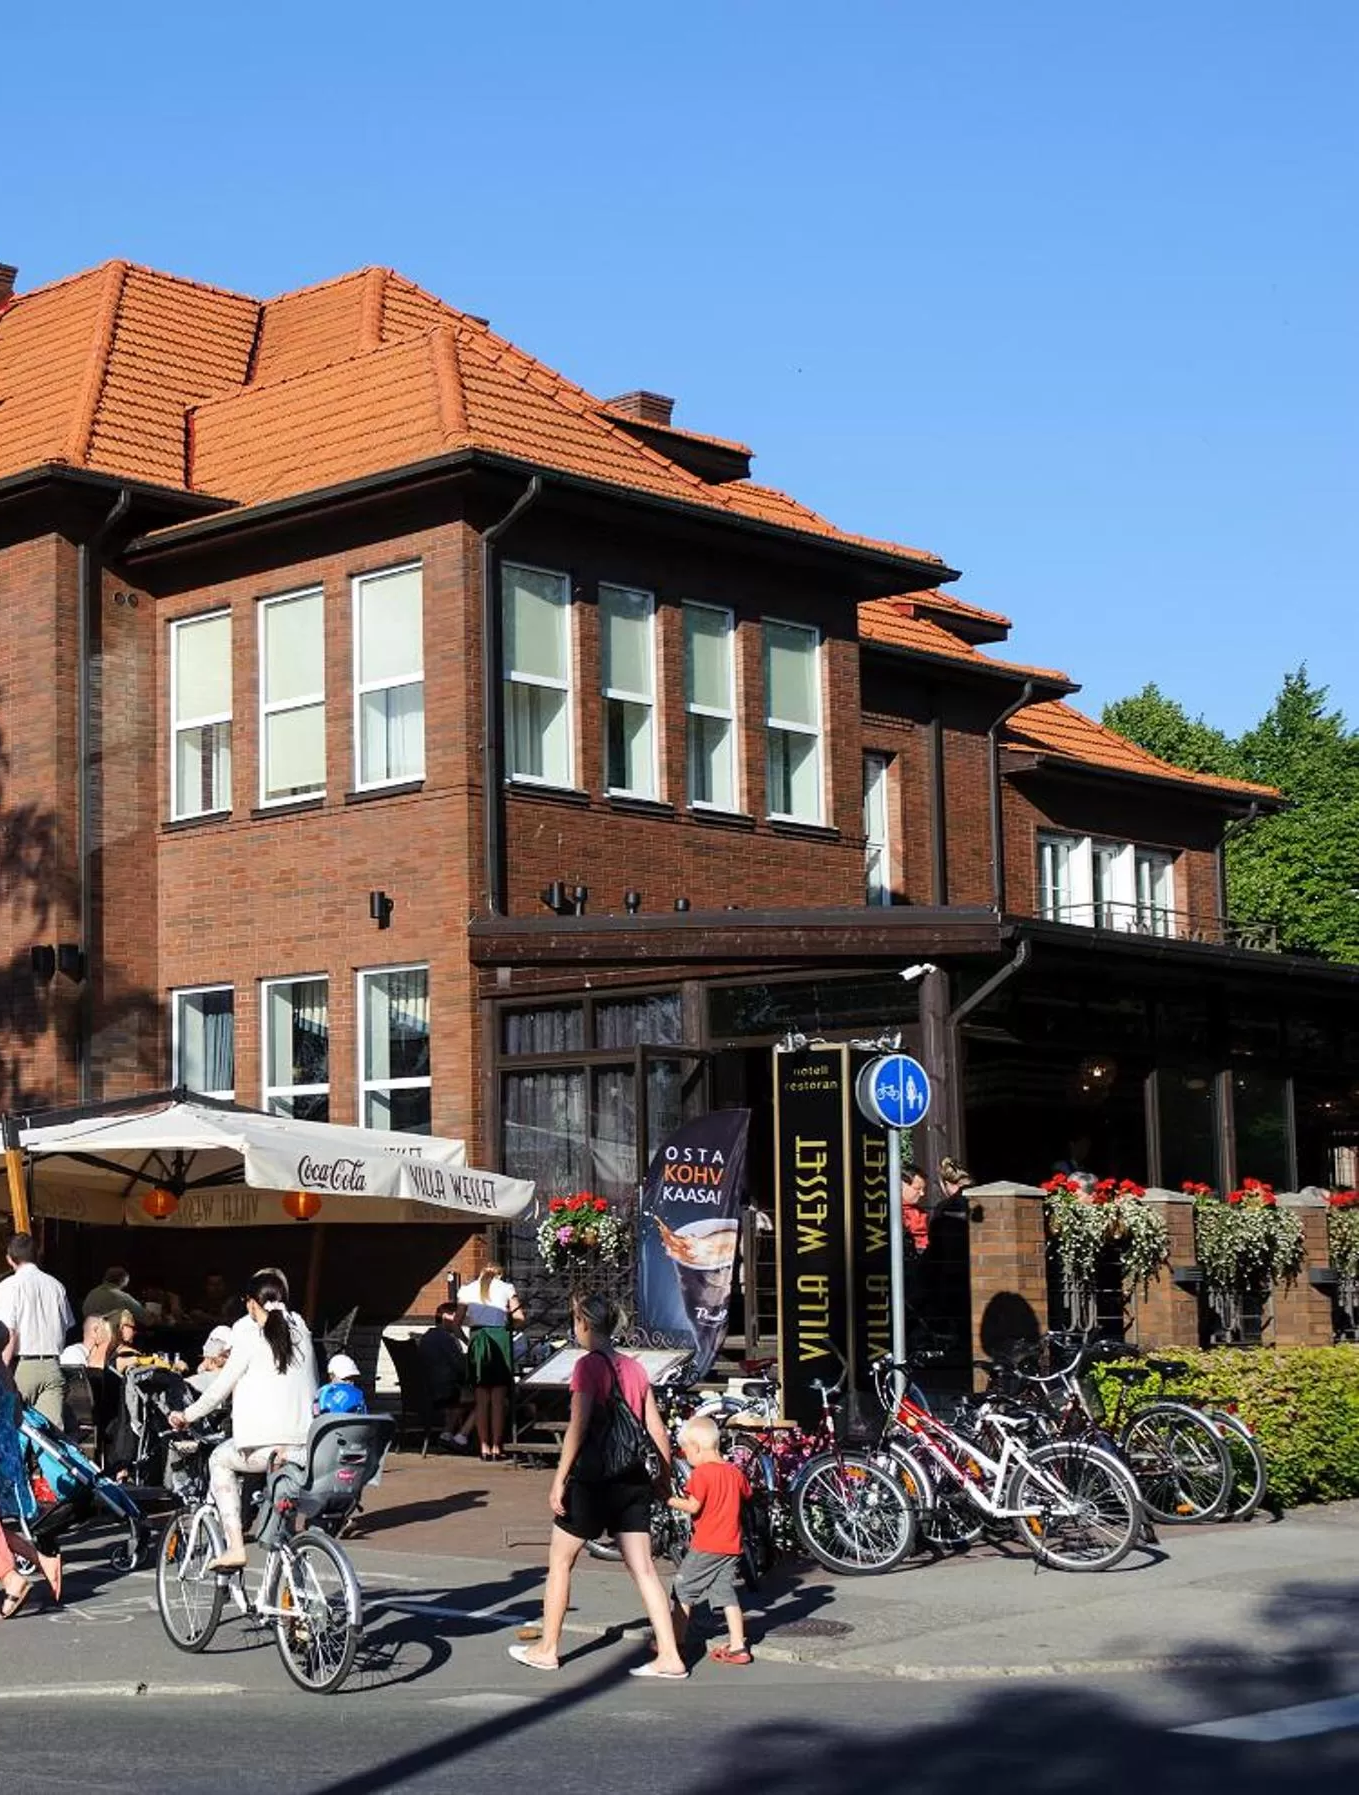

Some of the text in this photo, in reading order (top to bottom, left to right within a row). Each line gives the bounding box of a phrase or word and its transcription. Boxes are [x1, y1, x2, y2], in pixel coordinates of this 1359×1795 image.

[784, 1080, 838, 1092] restoran
[298, 1155, 367, 1191] Coca-Cola
[664, 1146, 724, 1165] OSTA
[409, 1164, 498, 1209] VILLA WESSET
[664, 1164, 723, 1186] KOHV
[863, 1133, 887, 1253] WESSET
[795, 1135, 831, 1362] VILLA WESSET
